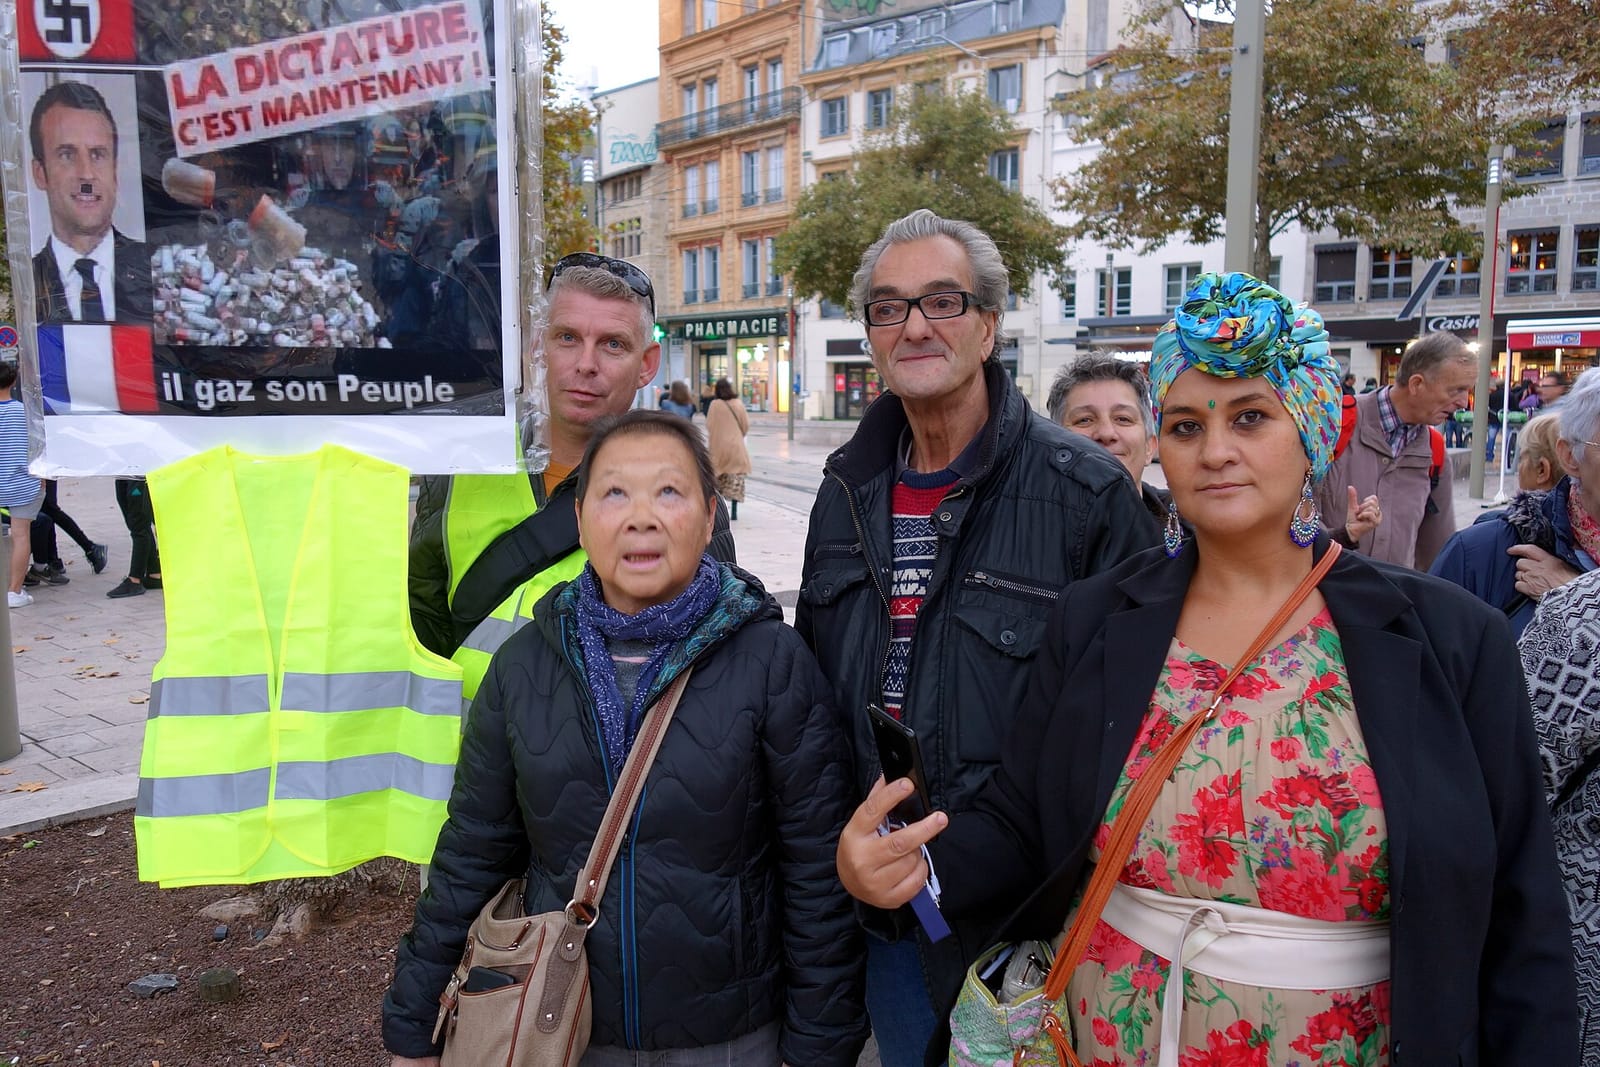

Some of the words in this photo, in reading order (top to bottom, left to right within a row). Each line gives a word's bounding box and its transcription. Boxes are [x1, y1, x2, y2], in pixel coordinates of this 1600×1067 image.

[170, 63, 228, 109] LA
[234, 5, 478, 92] DICTATURE,
[178, 107, 252, 146] C'EST
[685, 317, 777, 337] PHARMACIE
[1428, 315, 1480, 333] Casin
[162, 372, 183, 401] il
[194, 379, 255, 410] gaz
[265, 379, 326, 402] son
[337, 373, 455, 409] Peuple
